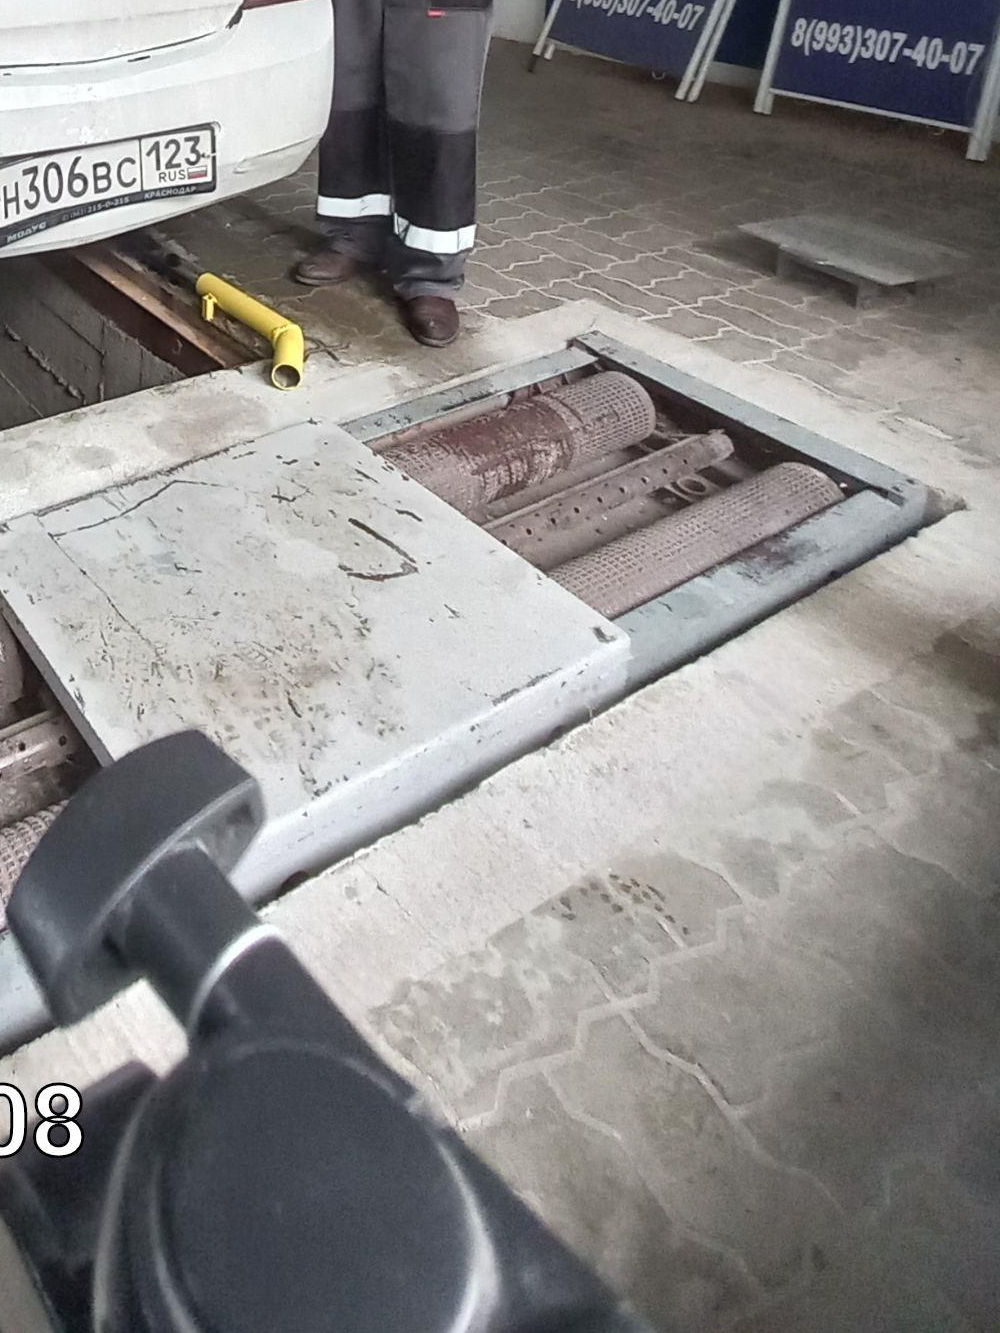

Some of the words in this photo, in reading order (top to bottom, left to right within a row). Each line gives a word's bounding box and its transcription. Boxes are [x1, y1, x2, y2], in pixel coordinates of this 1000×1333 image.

[791, 18, 985, 75] 8(993)307-40-07
[3, 155, 137, 219] Н306ВС
[146, 136, 201, 171] 123
[144, 185, 197, 199] КРАСНОДАР
[158, 169, 186, 183] RUS
